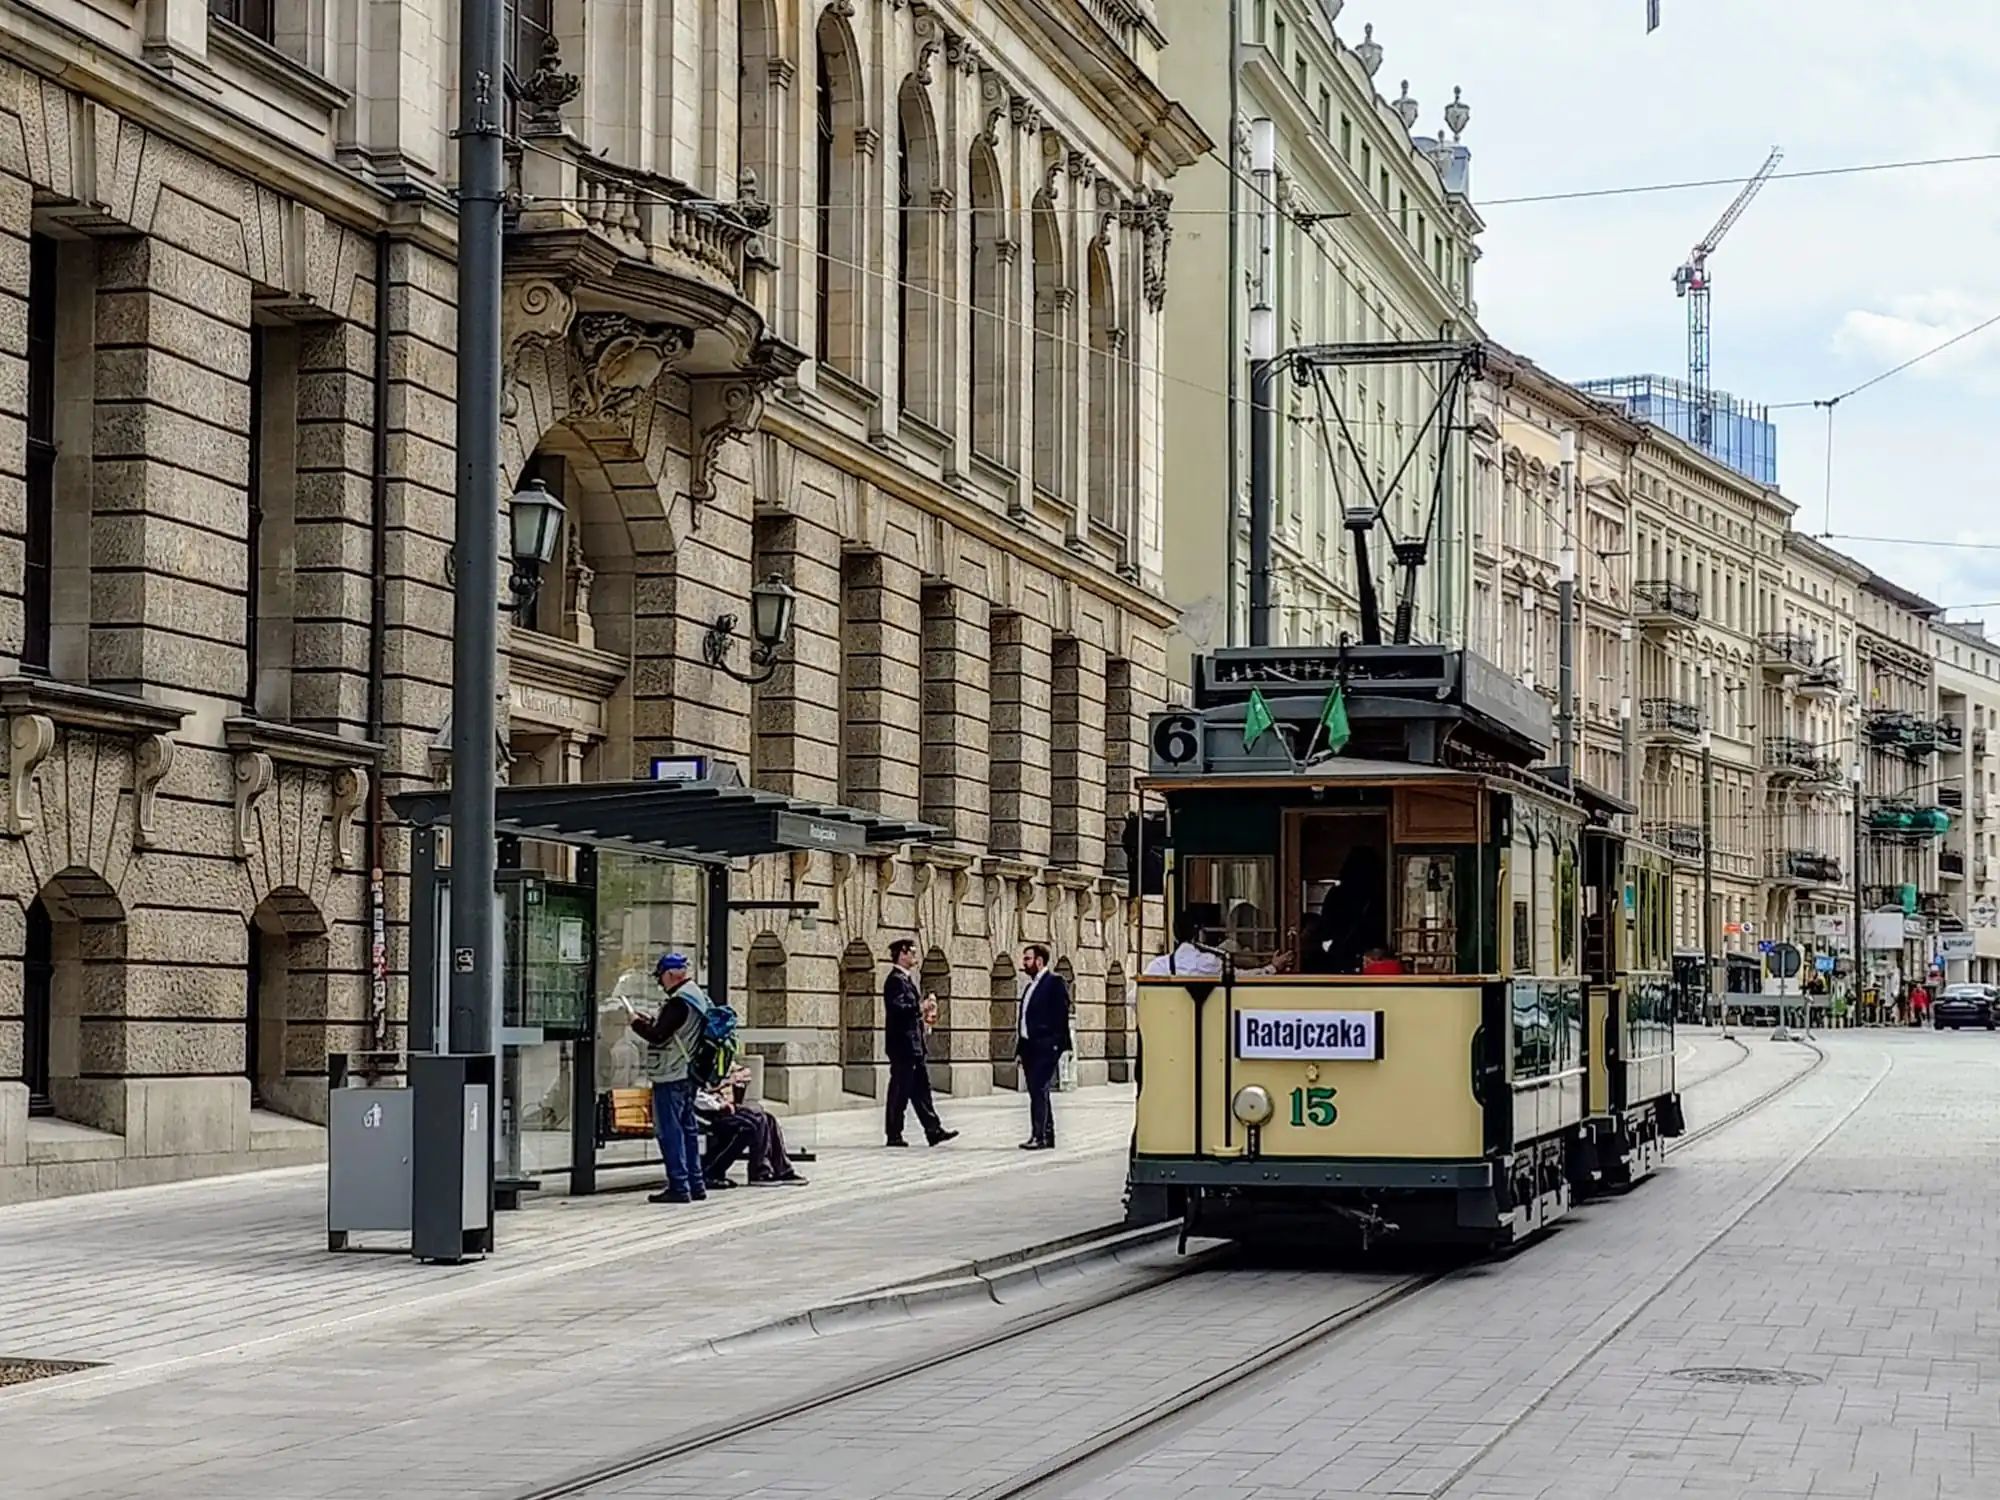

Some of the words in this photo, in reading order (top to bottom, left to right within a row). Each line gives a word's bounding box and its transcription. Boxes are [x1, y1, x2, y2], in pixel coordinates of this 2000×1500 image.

[1153, 716, 1198, 767] 6
[1246, 1018, 1366, 1050] Ratajczaka
[1289, 1086, 1338, 1127] 15
